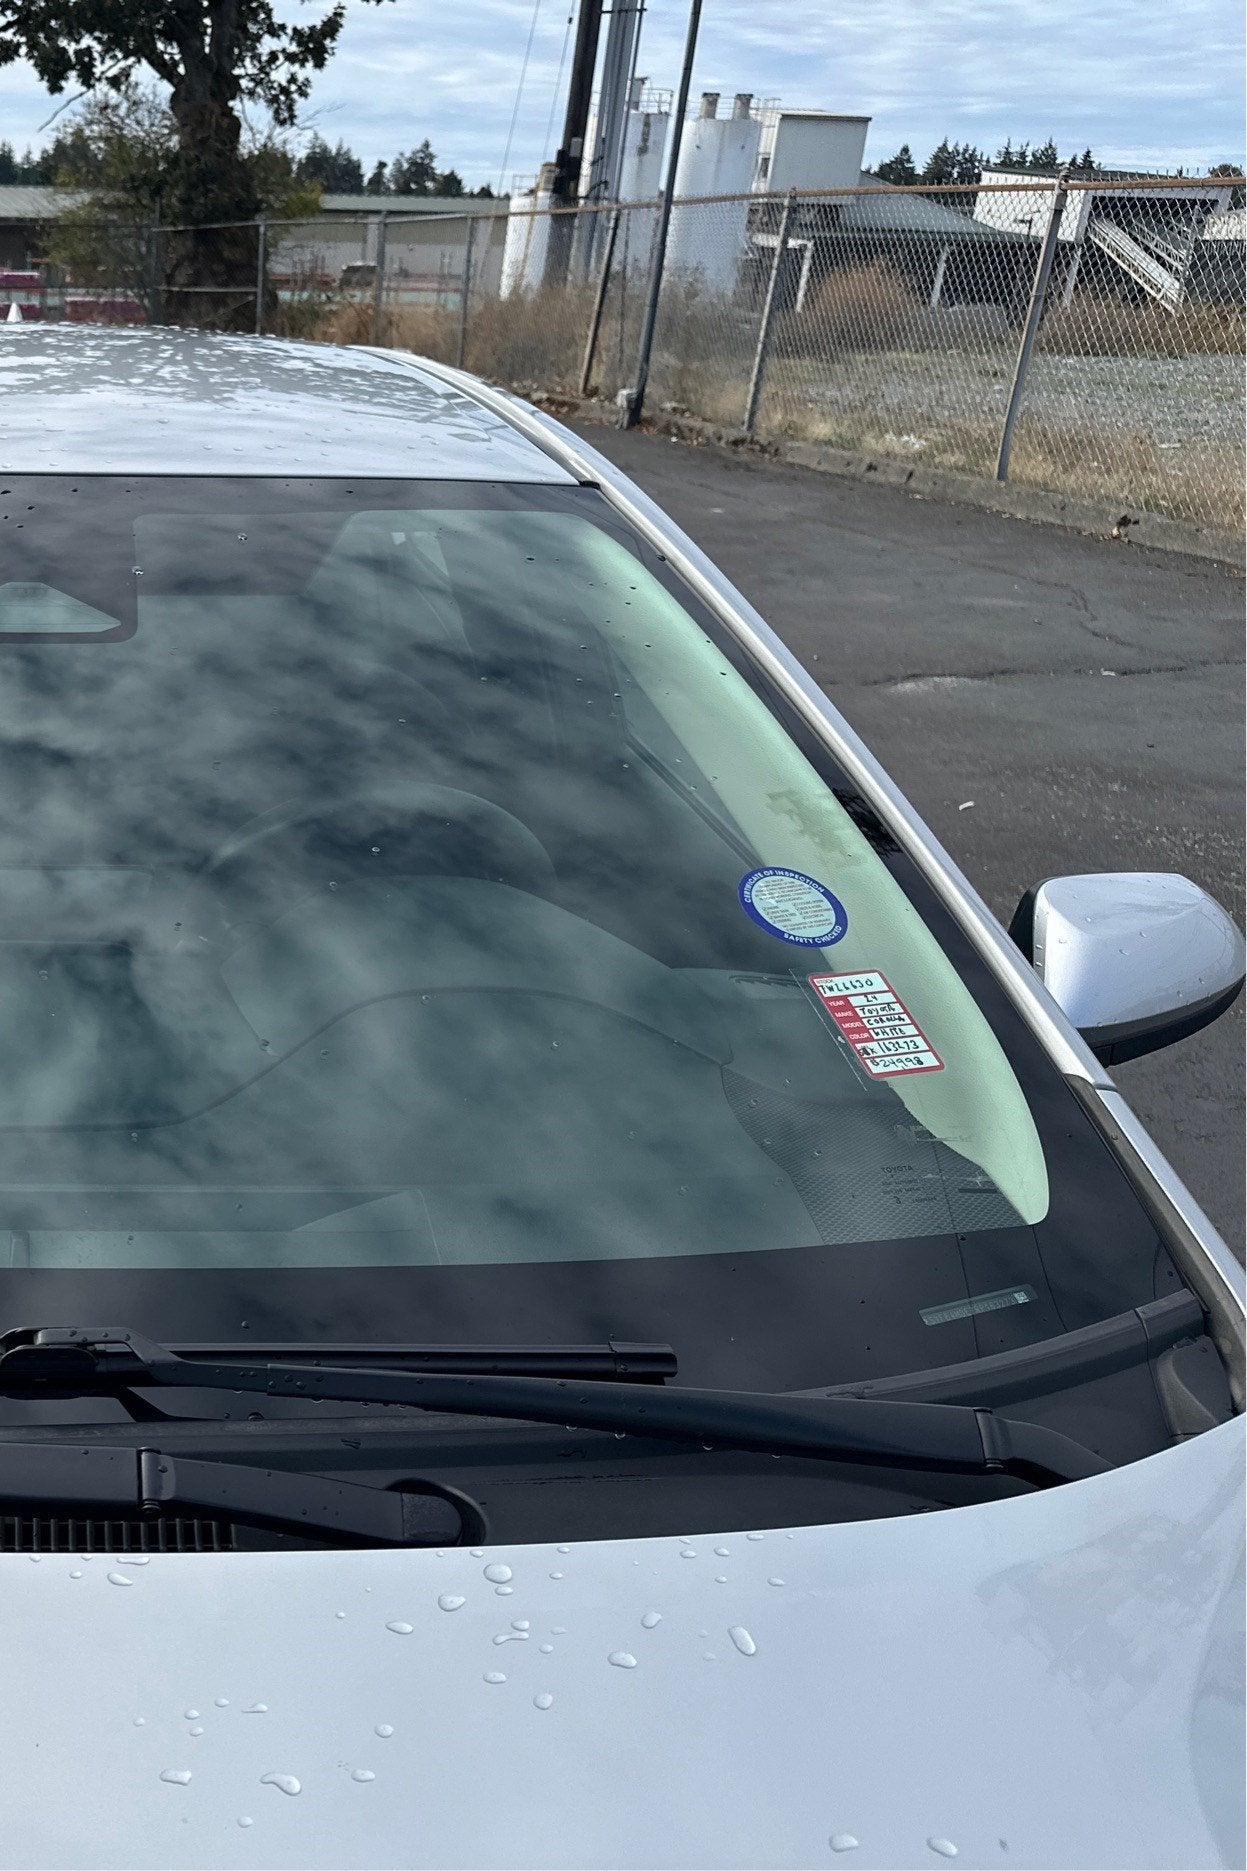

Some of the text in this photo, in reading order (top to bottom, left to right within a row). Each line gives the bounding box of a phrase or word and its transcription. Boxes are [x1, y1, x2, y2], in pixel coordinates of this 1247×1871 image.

[743, 871, 764, 903] CERTIFICATE
[763, 869, 774, 877] OF
[774, 869, 825, 893] INSPECTION
[783, 932, 814, 945] SAFETY
[814, 924, 842, 944] CHECKED
[841, 1021, 864, 1029] MODEL
[881, 1165, 914, 1174] TOYOTA
